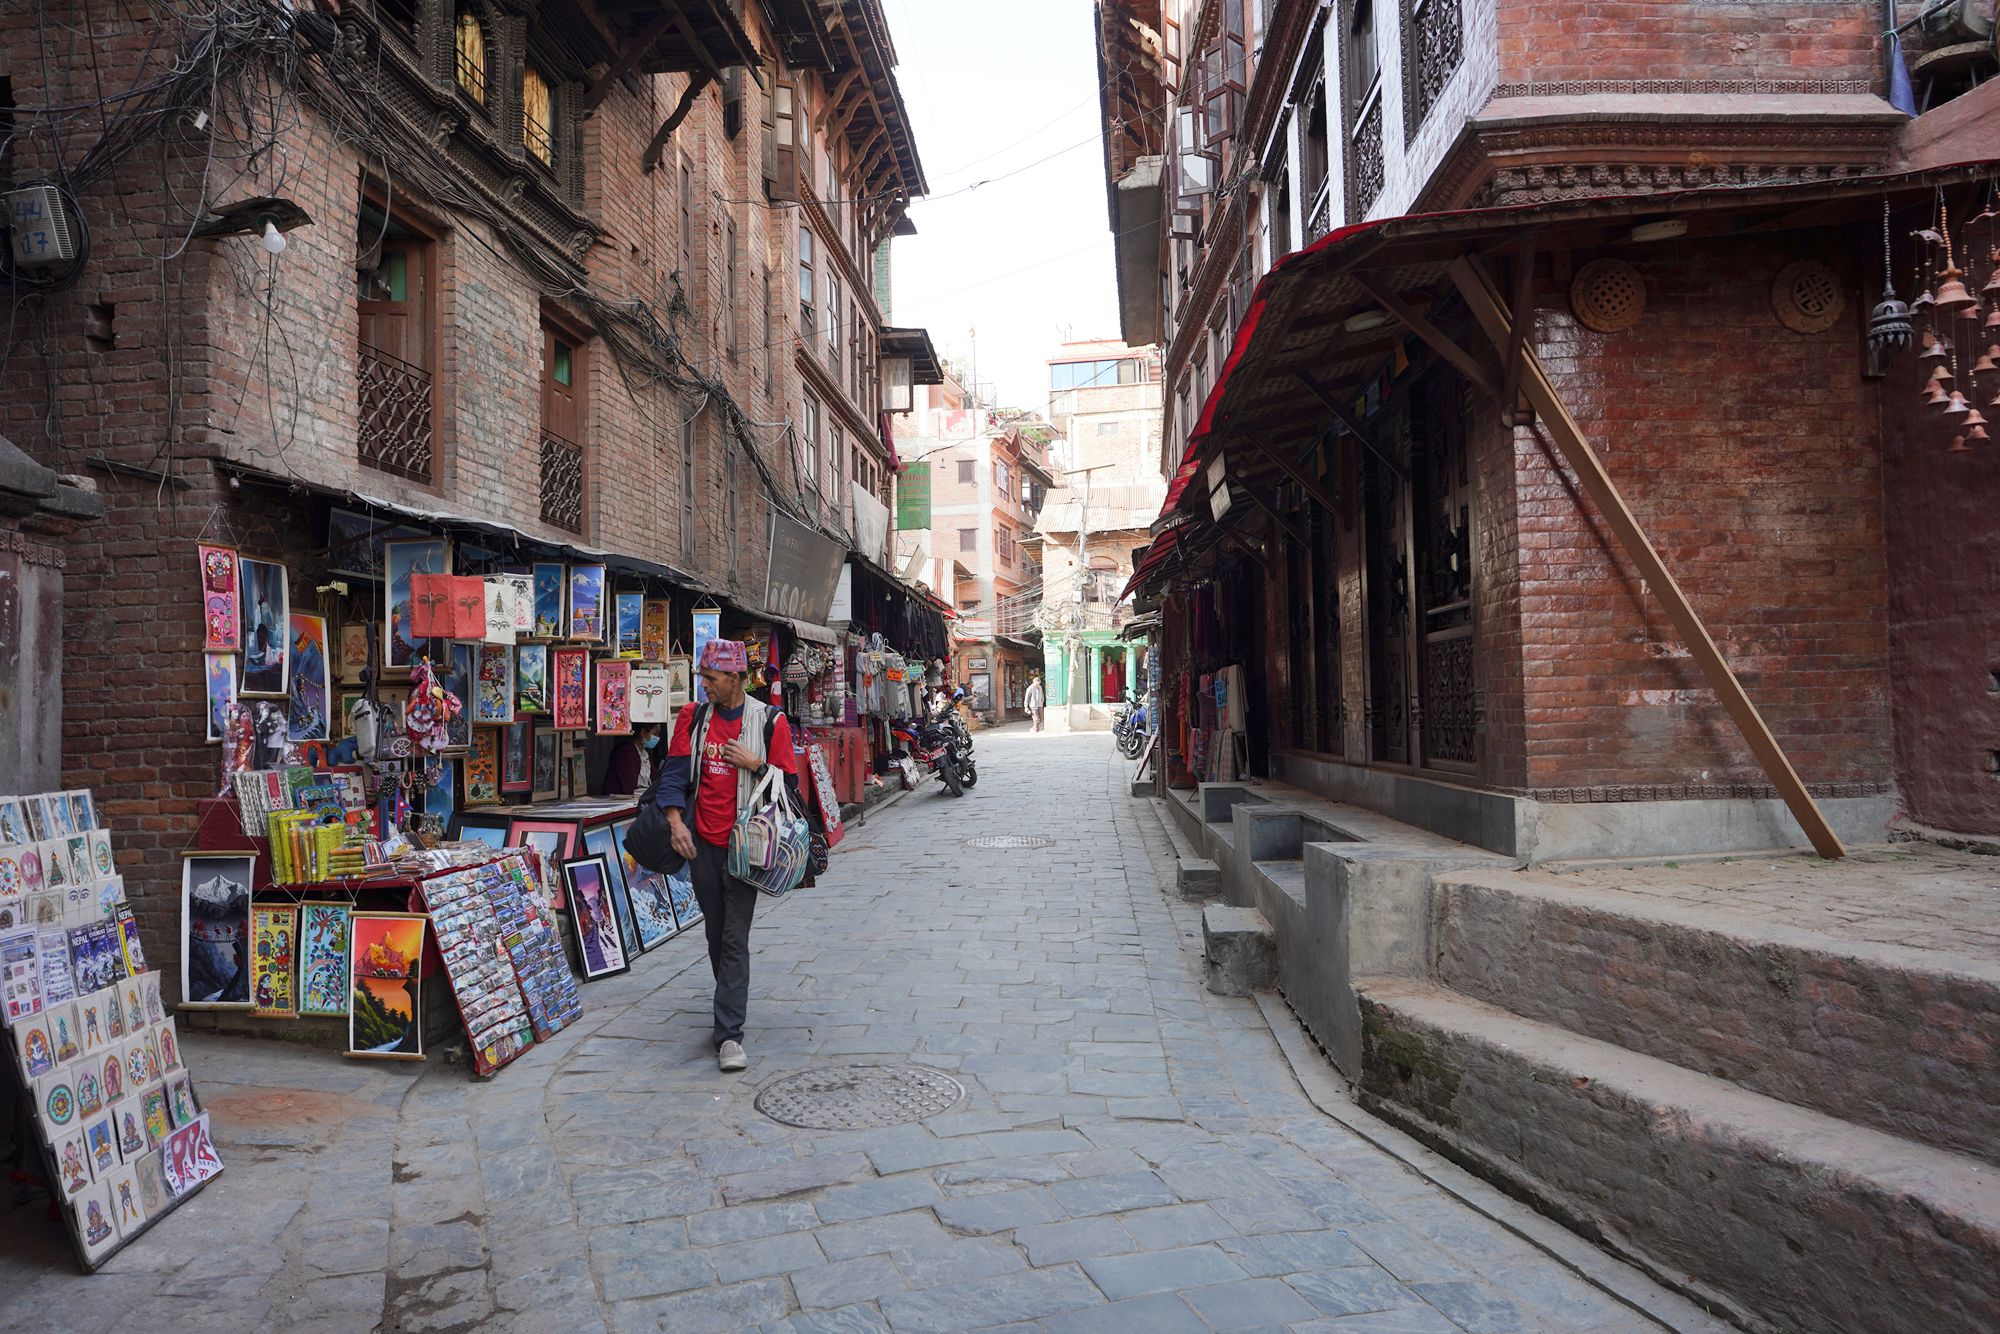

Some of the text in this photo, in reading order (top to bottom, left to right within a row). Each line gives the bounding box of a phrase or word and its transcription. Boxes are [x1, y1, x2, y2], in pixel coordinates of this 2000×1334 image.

[709, 766, 730, 775] NEPAL
[118, 909, 134, 921] NEPAL
[71, 935, 89, 947] NEPAL
[198, 1160, 218, 1169] NEPAL
